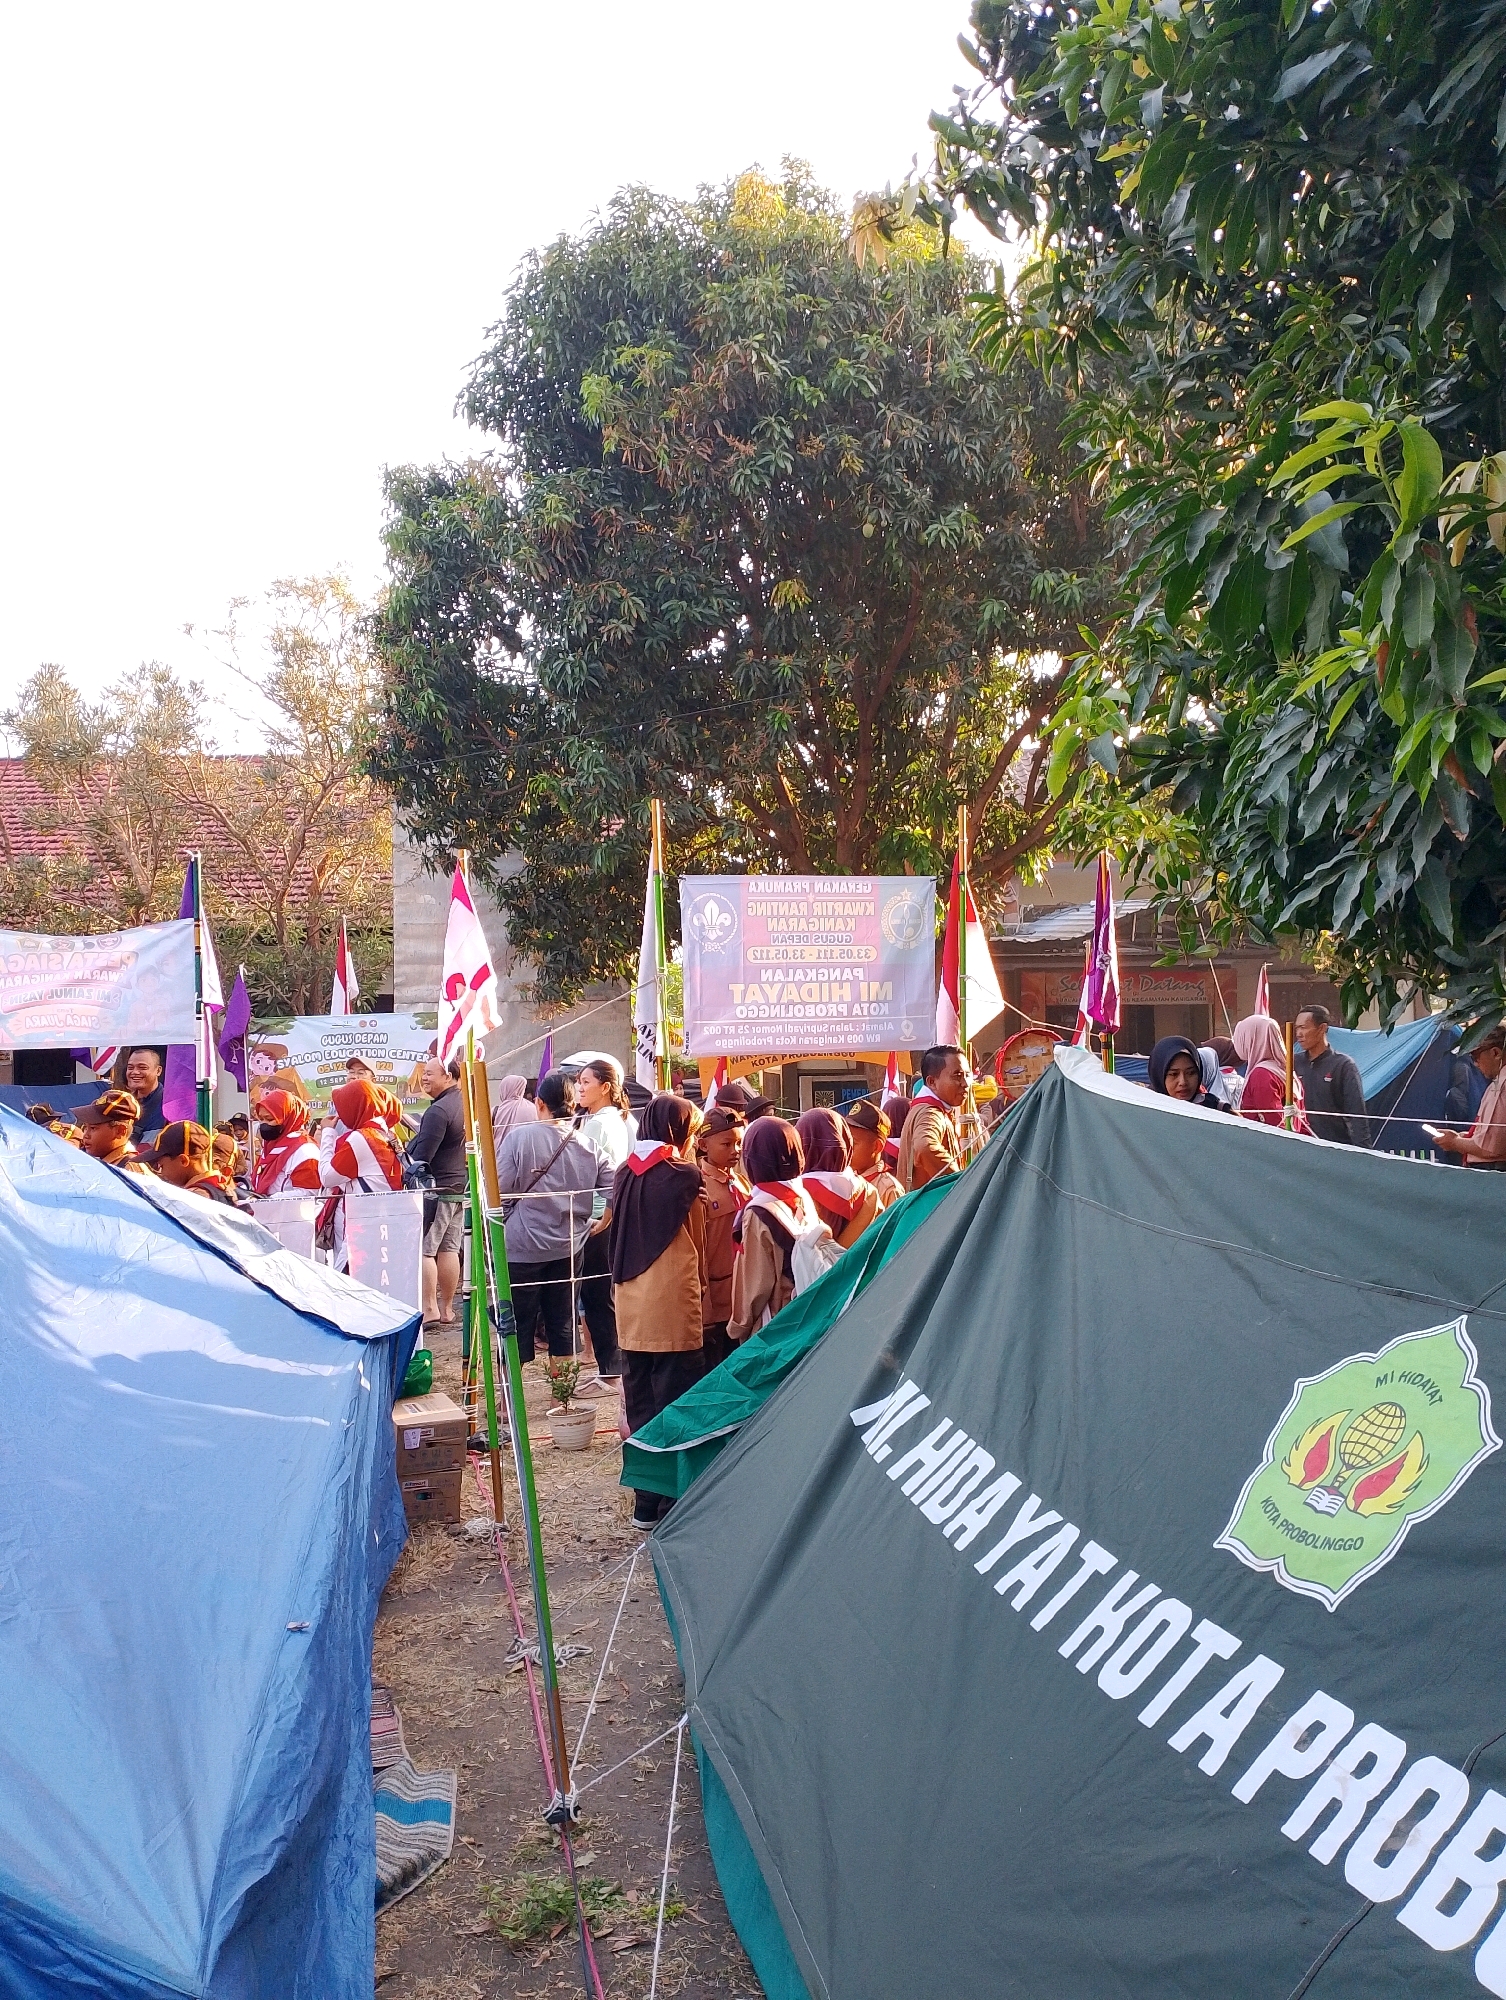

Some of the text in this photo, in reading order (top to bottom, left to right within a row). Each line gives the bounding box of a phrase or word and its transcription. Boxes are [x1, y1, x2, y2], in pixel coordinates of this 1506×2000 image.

[1139, 974, 1205, 996] Datang
[321, 1033, 388, 1046] GUGUS DEPAN
[276, 1048, 430, 1069] SYALOM EDUCATION CENTER
[751, 1055, 779, 1068] KOTA
[1375, 1370, 1443, 1407] MI HIDAYAT
[1260, 1495, 1364, 1551] KOTA PROBOLINGGO
[886, 1416, 1119, 1632] HIDAYAT
[1058, 1569, 1285, 1777] KOTA
